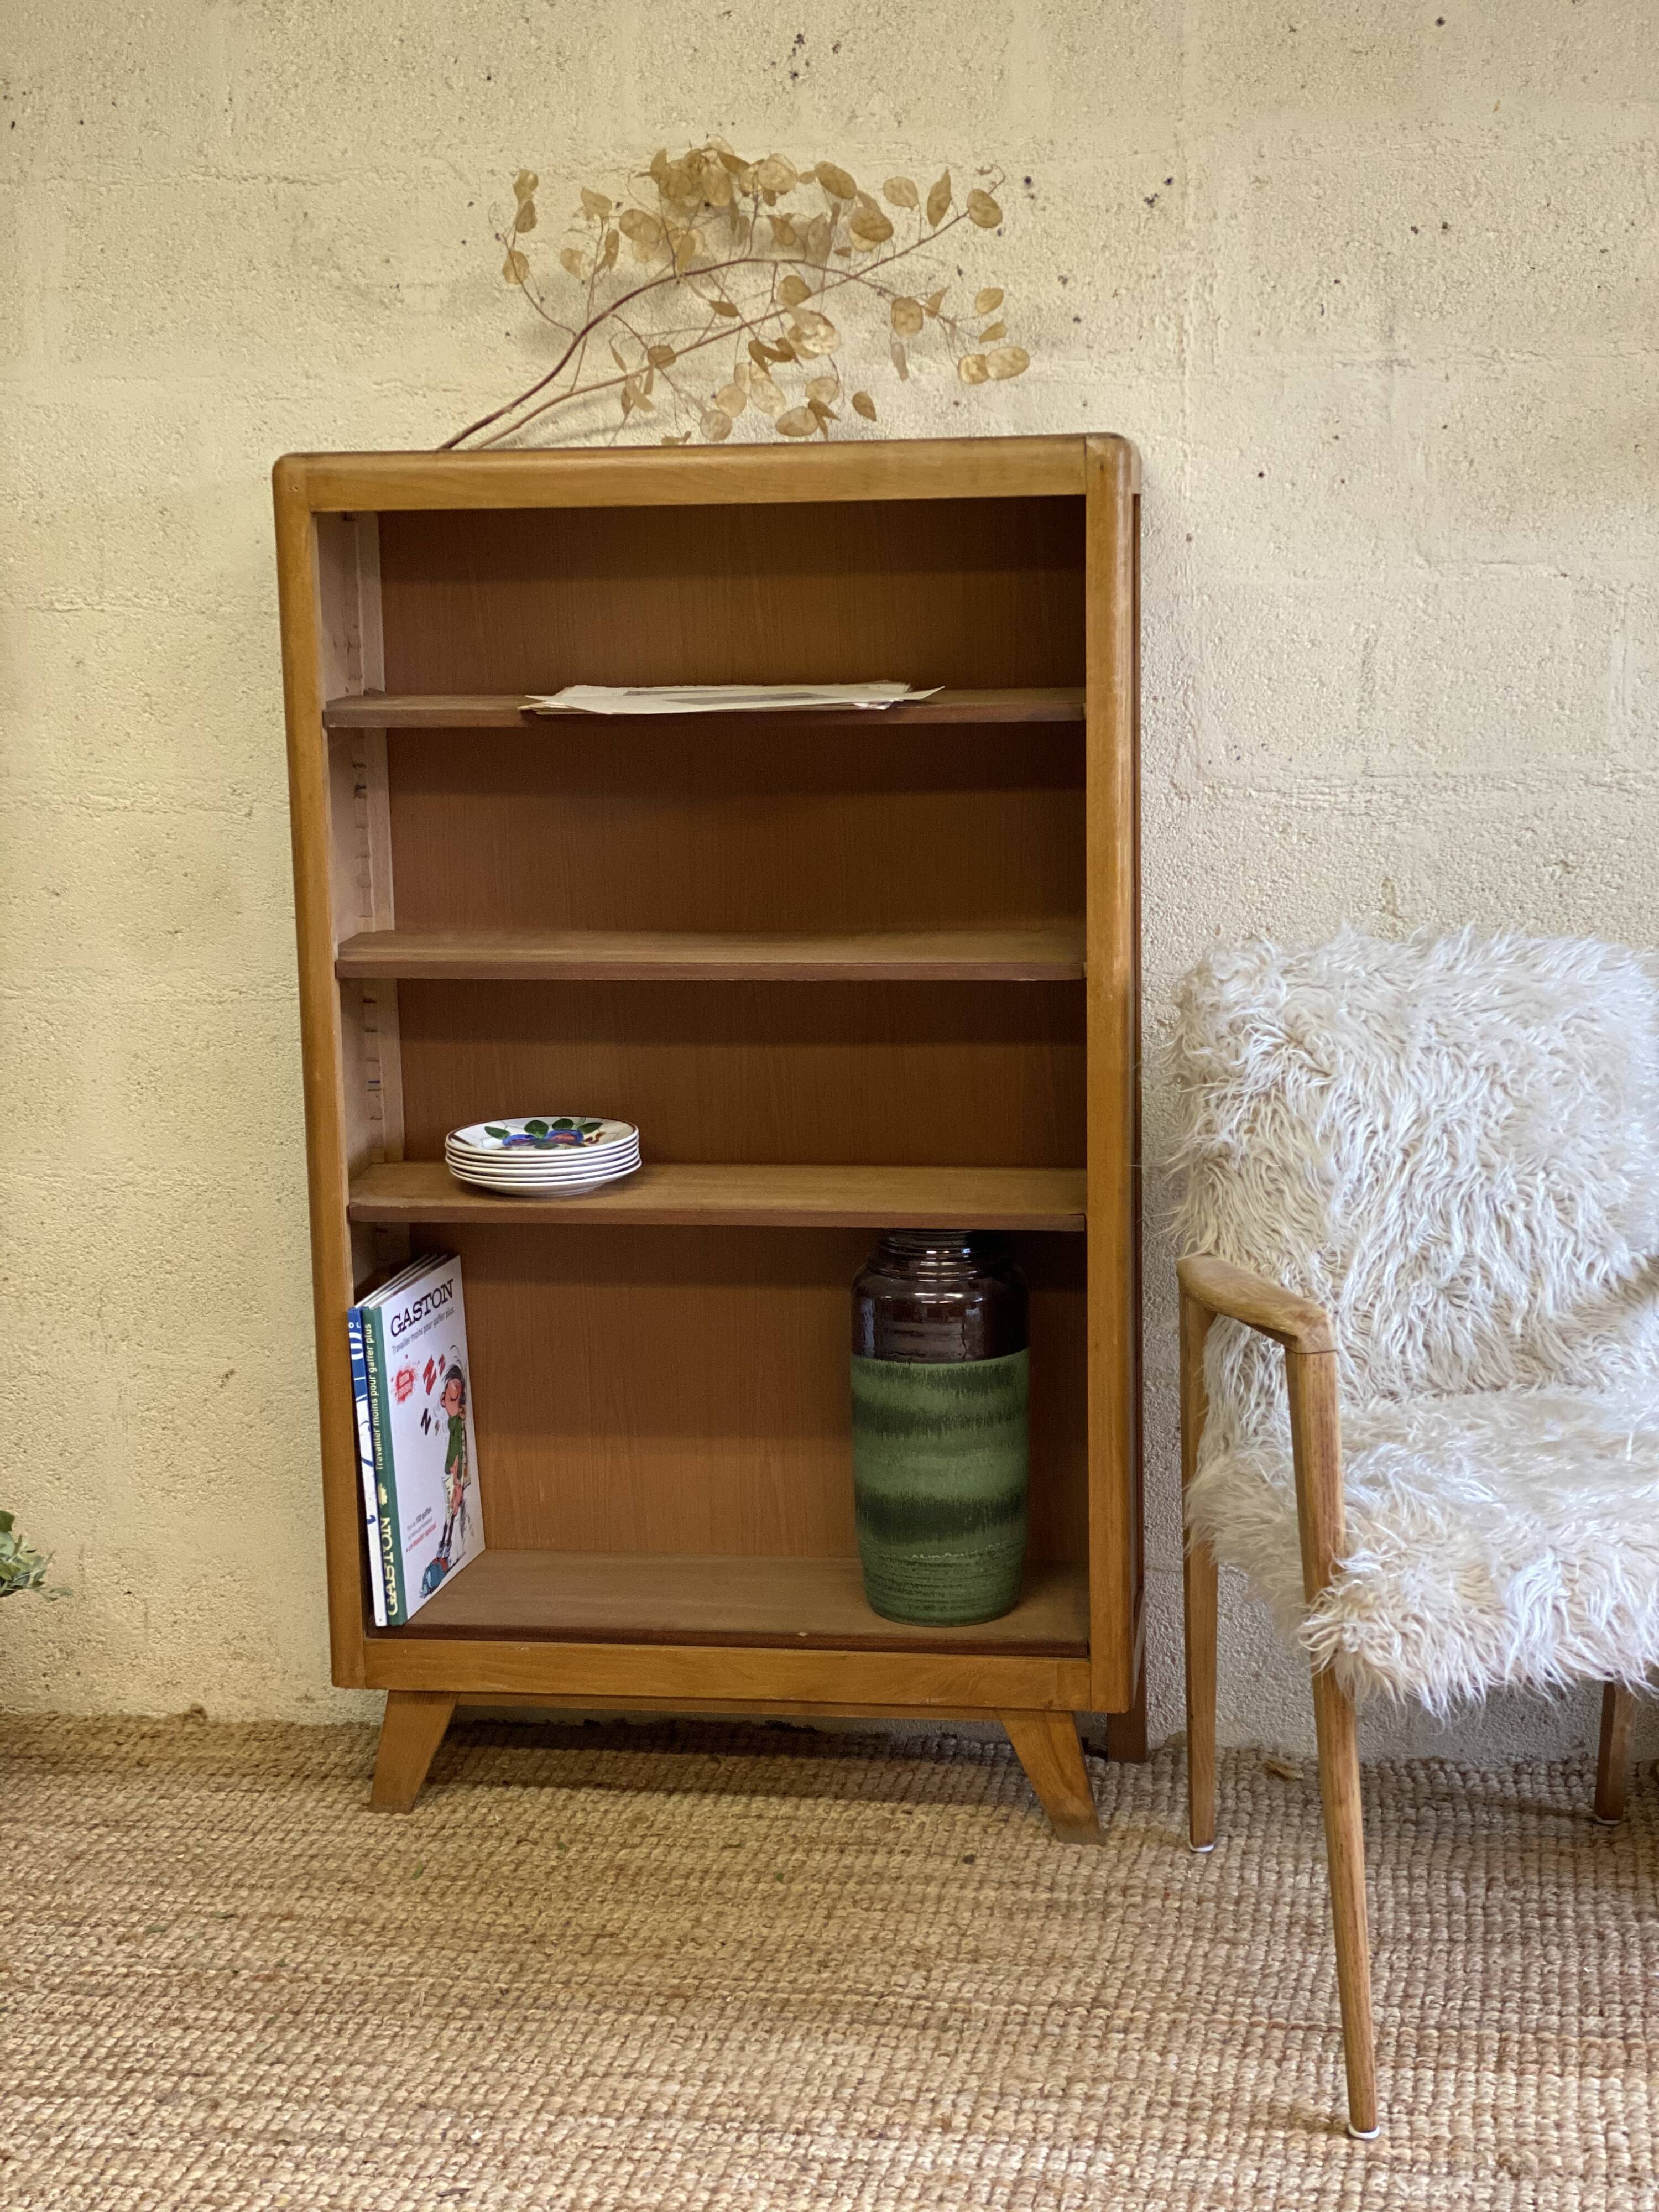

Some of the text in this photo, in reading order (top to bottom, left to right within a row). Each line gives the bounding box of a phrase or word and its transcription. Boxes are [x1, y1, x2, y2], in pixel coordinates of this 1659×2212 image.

[391, 1278, 453, 1337] GASTON
[392, 1306, 455, 1354] Travailler moins pour gaffer plus
[365, 1324, 383, 1469] Travailler moins pour gaffer plus
[381, 1517, 398, 1615] GASTON
